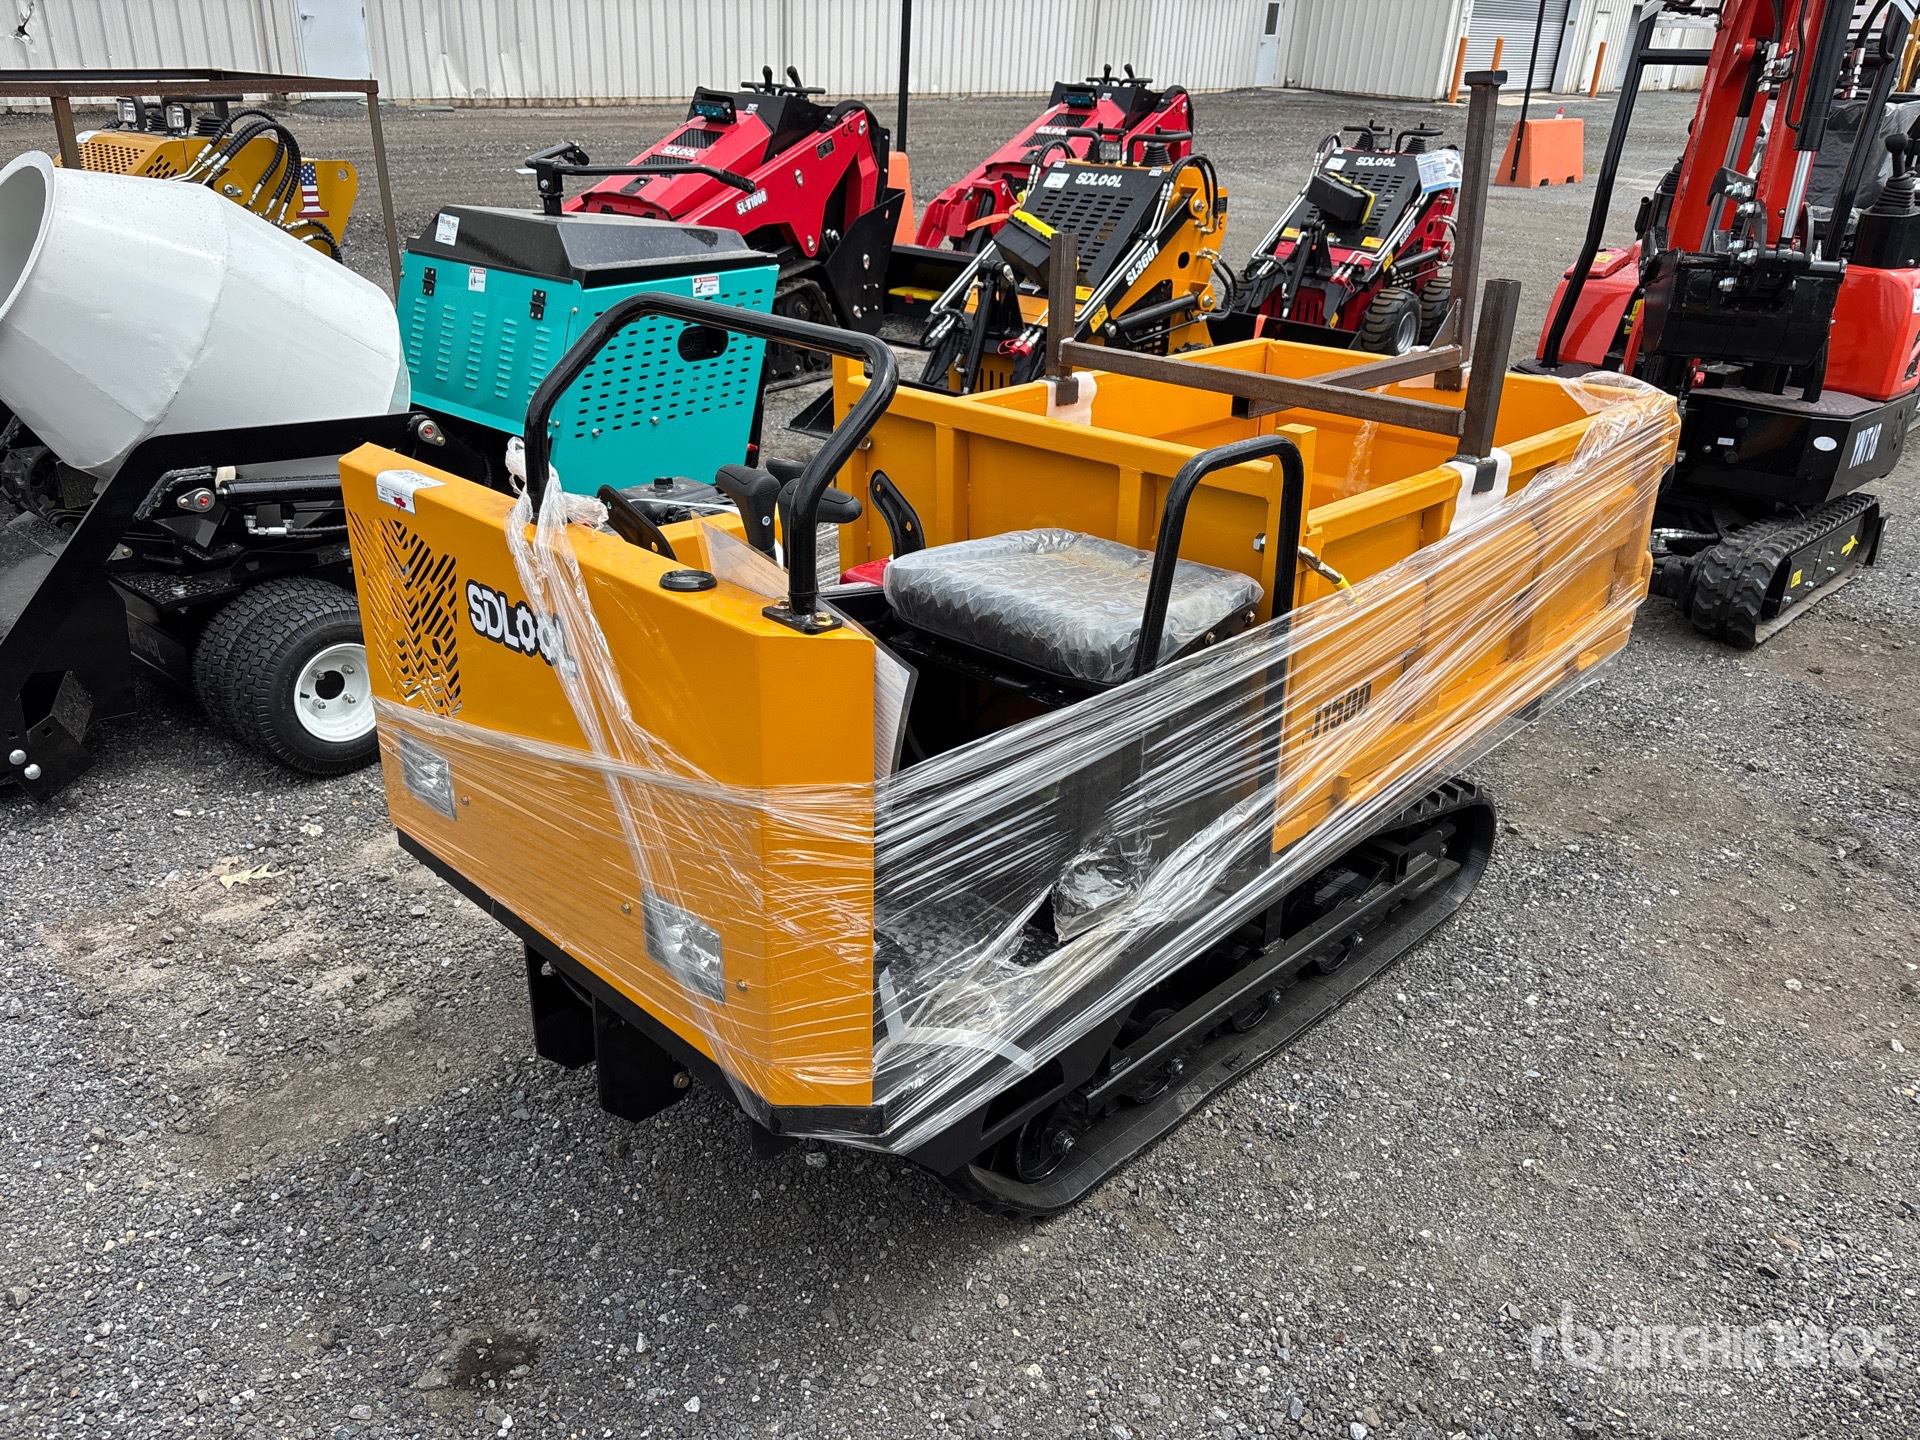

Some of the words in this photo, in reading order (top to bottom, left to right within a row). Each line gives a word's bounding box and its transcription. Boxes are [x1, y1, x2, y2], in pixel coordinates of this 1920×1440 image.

[661, 145, 698, 158] SDLOOL
[1356, 156, 1397, 167] SDLOOL
[1075, 172, 1123, 188] SDLOOL
[736, 189, 767, 216] SL-V1000
[1125, 240, 1160, 287] SL360T
[467, 581, 577, 676] SDLOOL
